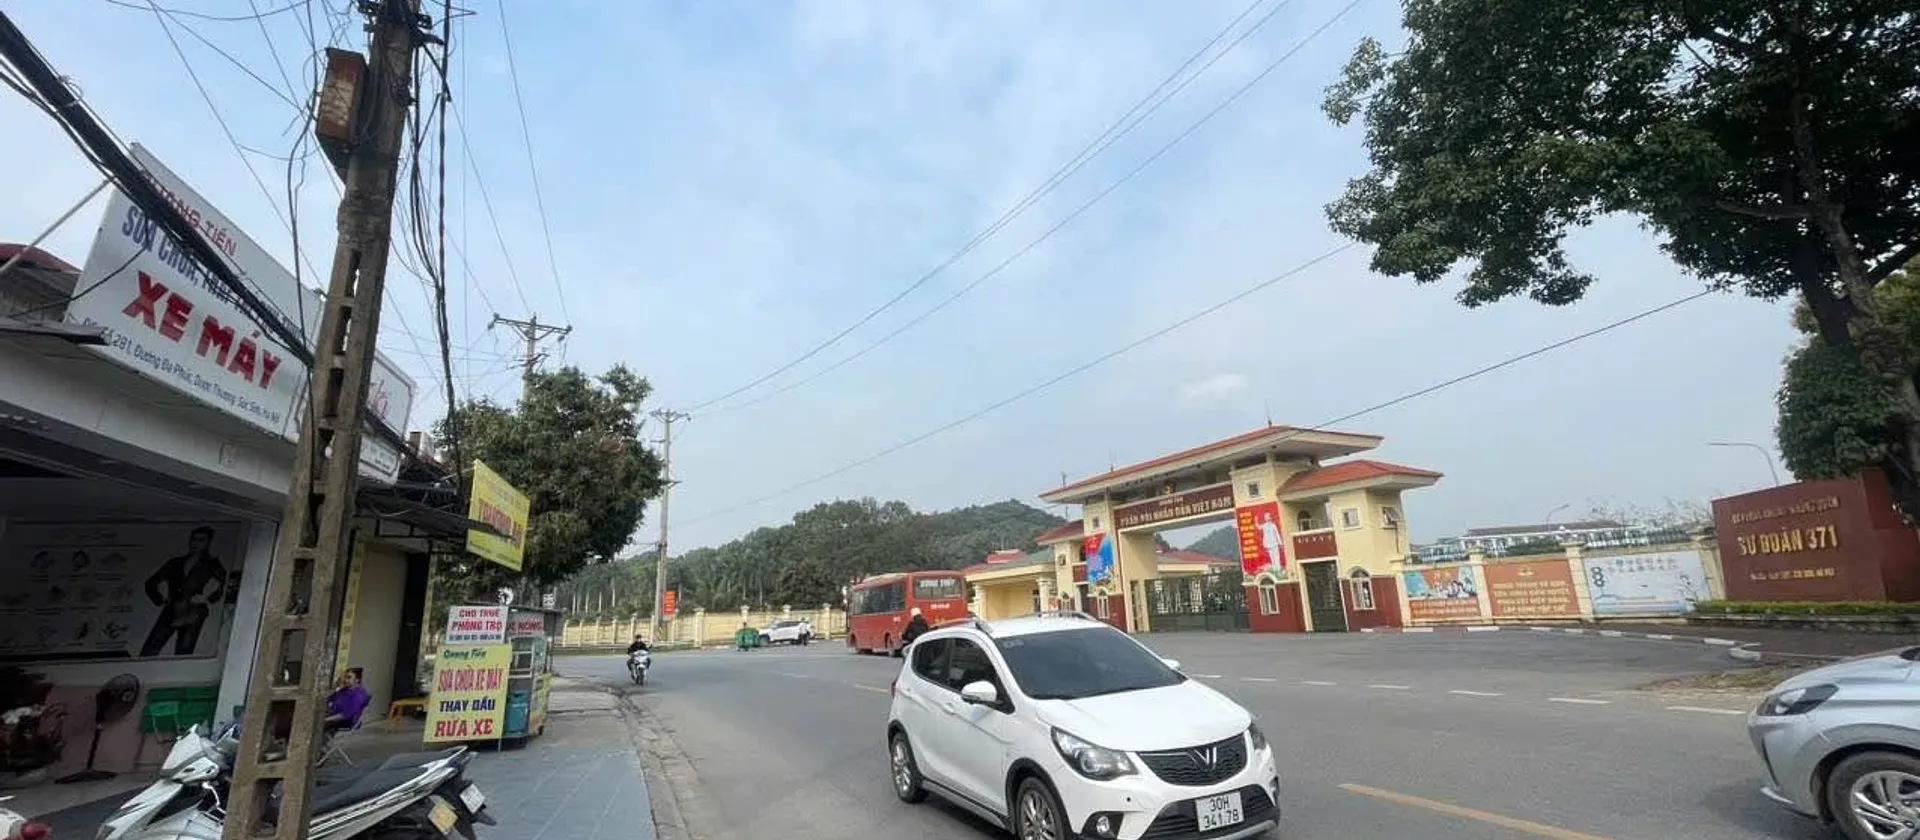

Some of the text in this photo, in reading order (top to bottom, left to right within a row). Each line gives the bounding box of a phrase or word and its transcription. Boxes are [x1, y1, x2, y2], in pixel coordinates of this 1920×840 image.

[121, 270, 194, 343] XE
[195, 315, 282, 390] MÁY
[1760, 526, 1803, 555] ĐOÀN
[1806, 525, 1838, 550] 371
[459, 609, 477, 618] CHO
[439, 699, 468, 712] THAY
[472, 718, 494, 736] XE
[1209, 795, 1231, 812] 30H
